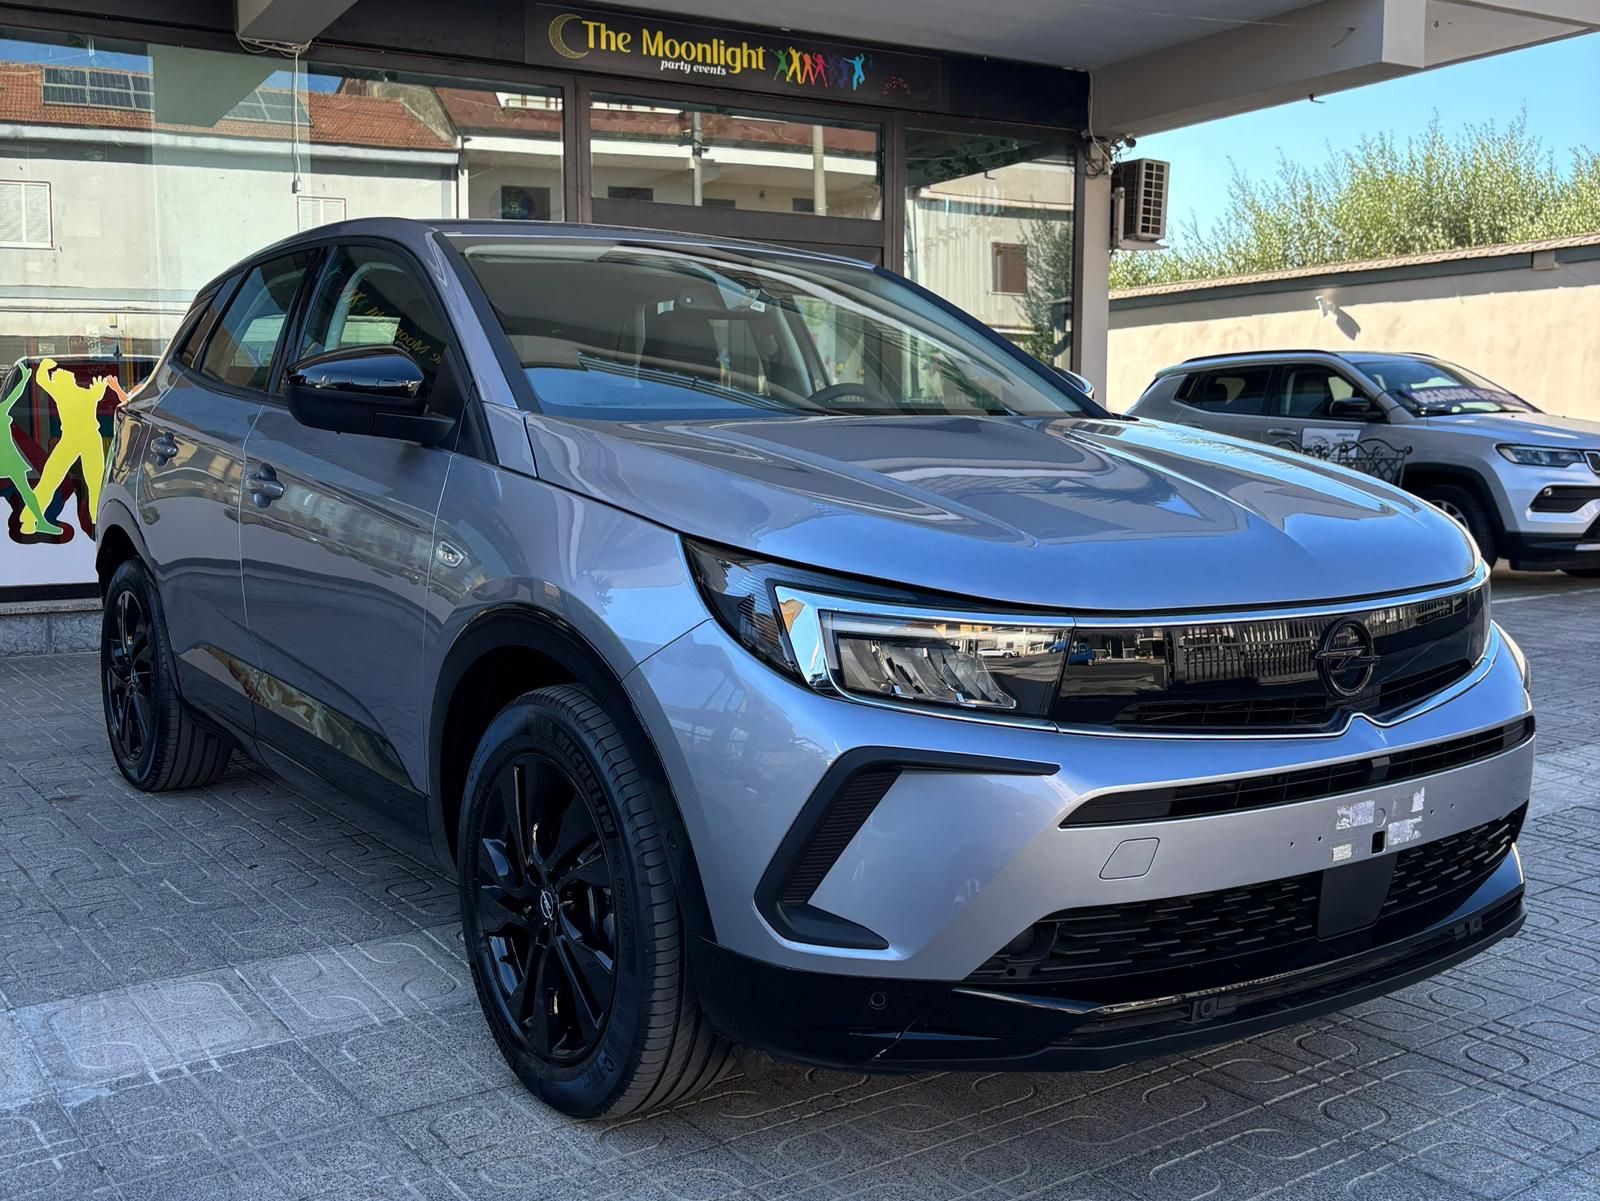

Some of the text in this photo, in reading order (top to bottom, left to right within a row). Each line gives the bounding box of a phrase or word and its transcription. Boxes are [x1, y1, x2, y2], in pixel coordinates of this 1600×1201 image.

[582, 20, 766, 74] The Moonlight
[660, 60, 727, 75] party events
[554, 731, 617, 834] MICHELIN
